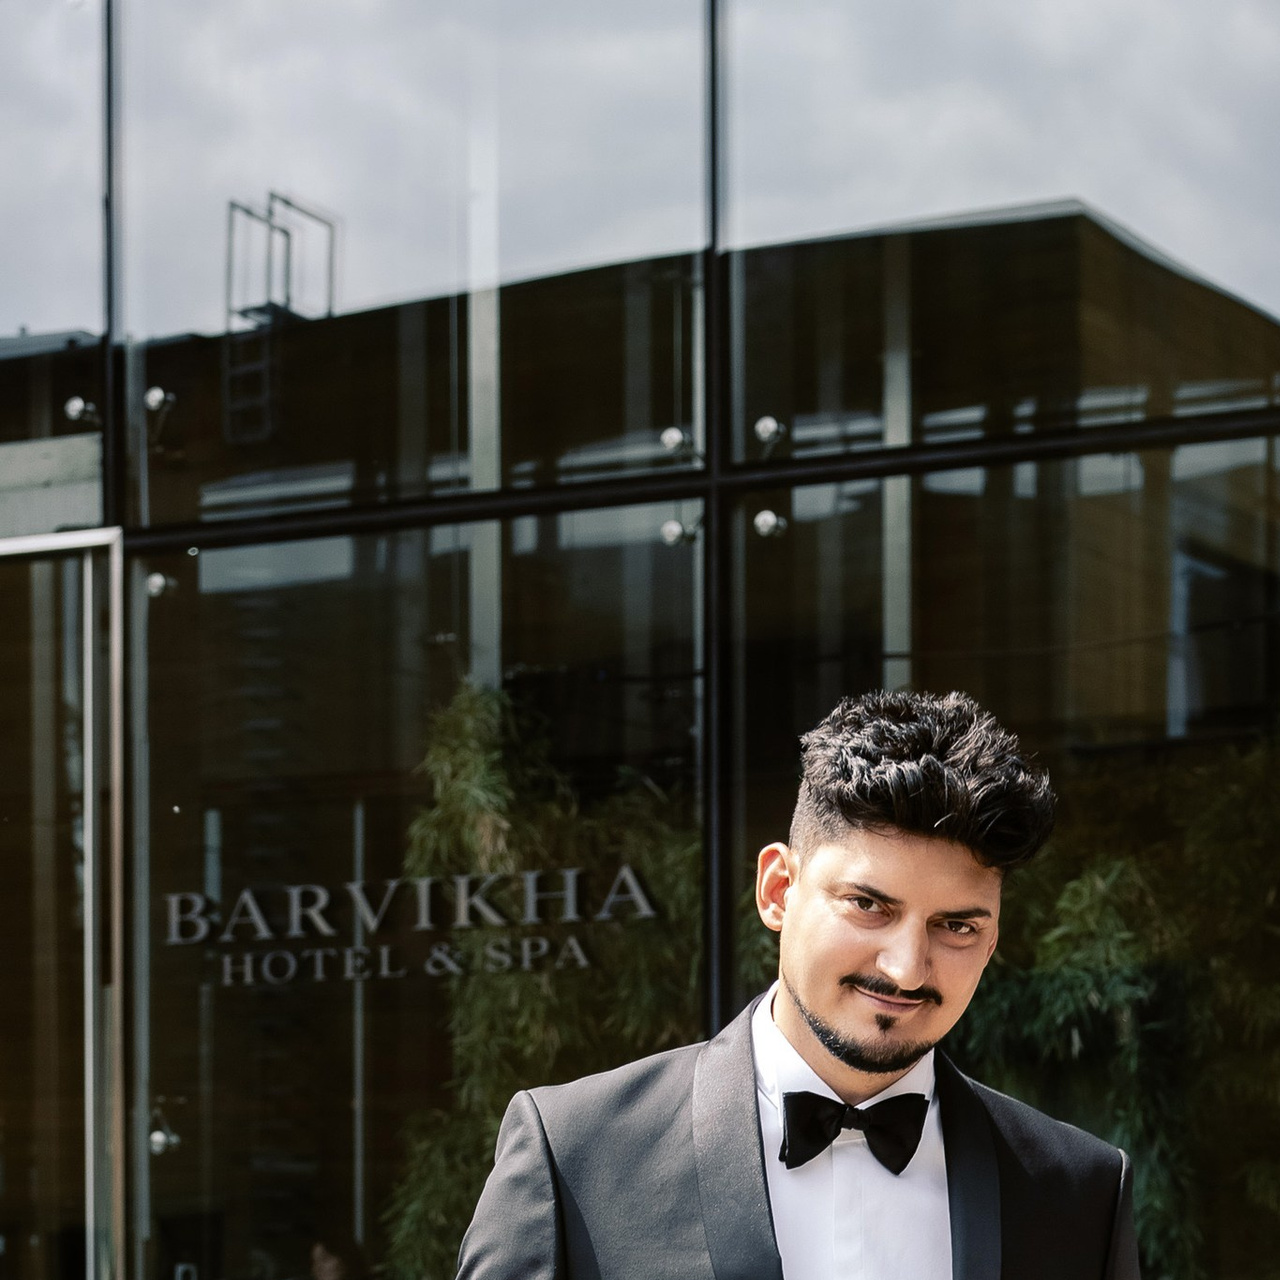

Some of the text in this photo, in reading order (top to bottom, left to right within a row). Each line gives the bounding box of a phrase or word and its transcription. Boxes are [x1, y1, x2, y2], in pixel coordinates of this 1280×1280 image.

[165, 864, 656, 946] BARVIKHA
[221, 935, 591, 986] HOTEL & SPA
